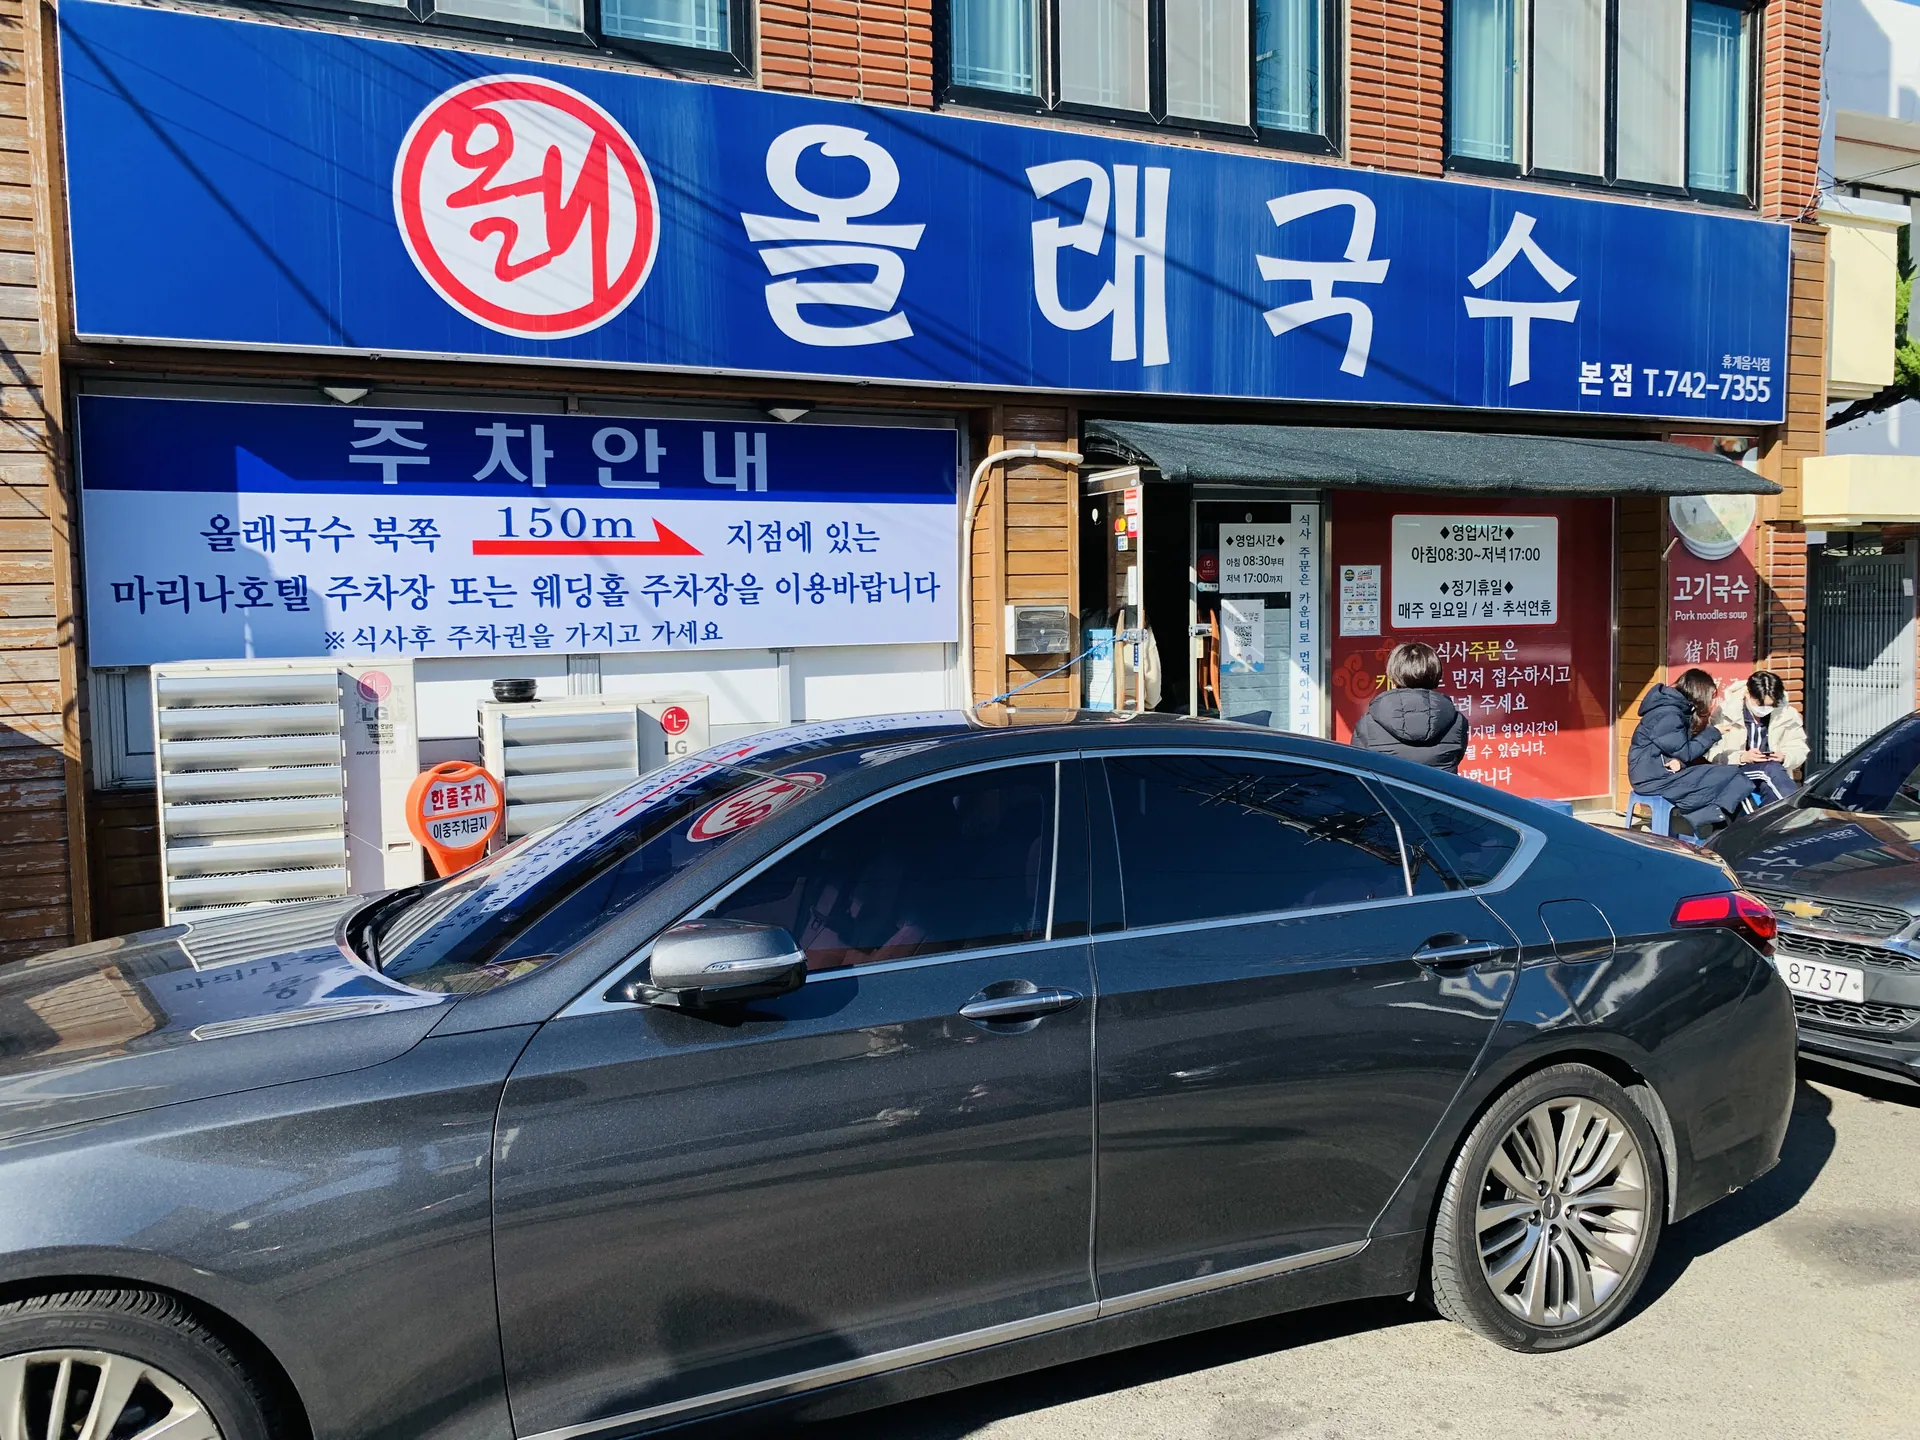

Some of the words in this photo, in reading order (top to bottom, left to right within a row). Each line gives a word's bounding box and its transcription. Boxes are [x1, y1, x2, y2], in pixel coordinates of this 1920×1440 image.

[741, 124, 1580, 387] 올래국수
[1721, 354, 1771, 372] 휴게음식점
[200, 513, 355, 553] 올래국수
[367, 516, 441, 553] 북쪽
[497, 506, 636, 539] 150m
[726, 520, 812, 554] 지점에
[826, 521, 881, 554] 있는
[1299, 514, 1311, 540] 식사
[1452, 524, 1503, 542] 영업시간
[1226, 557, 1241, 567] 아침
[1299, 547, 1311, 586] 주문은
[1226, 574, 1241, 583] 저녁
[1451, 579, 1502, 597] 정기휴일
[1673, 573, 1750, 605] 고기국수
[111, 573, 311, 615] 마리나호텔
[325, 573, 436, 611] 주차장
[447, 574, 518, 609] 또는
[530, 572, 630, 609] 웨딩홀
[640, 571, 764, 608] 주차장을
[775, 570, 941, 605] 이용바랍니다
[1298, 592, 1311, 643] 카운터로
[1398, 602, 1425, 619] 매주
[1429, 601, 1467, 619] 일요일
[1675, 609, 1696, 621] Pork
[1696, 609, 1728, 620] noodles
[1728, 611, 1748, 620] soup
[446, 622, 555, 650] 주차권을
[565, 621, 641, 648] 가지고
[651, 619, 724, 645] 가세요
[1436, 638, 1518, 664] 식사주문은
[1684, 638, 1739, 663] 猪肉面
[1452, 668, 1484, 690] 먼저
[1491, 665, 1571, 688] 접수하시고
[362, 706, 389, 722] LG
[1479, 692, 1529, 715] 주세요
[1501, 720, 1558, 739] 영업시간이
[664, 740, 688, 756] LG
[1480, 744, 1494, 760] 수
[433, 816, 487, 839] 이중주차금지
[1788, 962, 1848, 994] 8737
